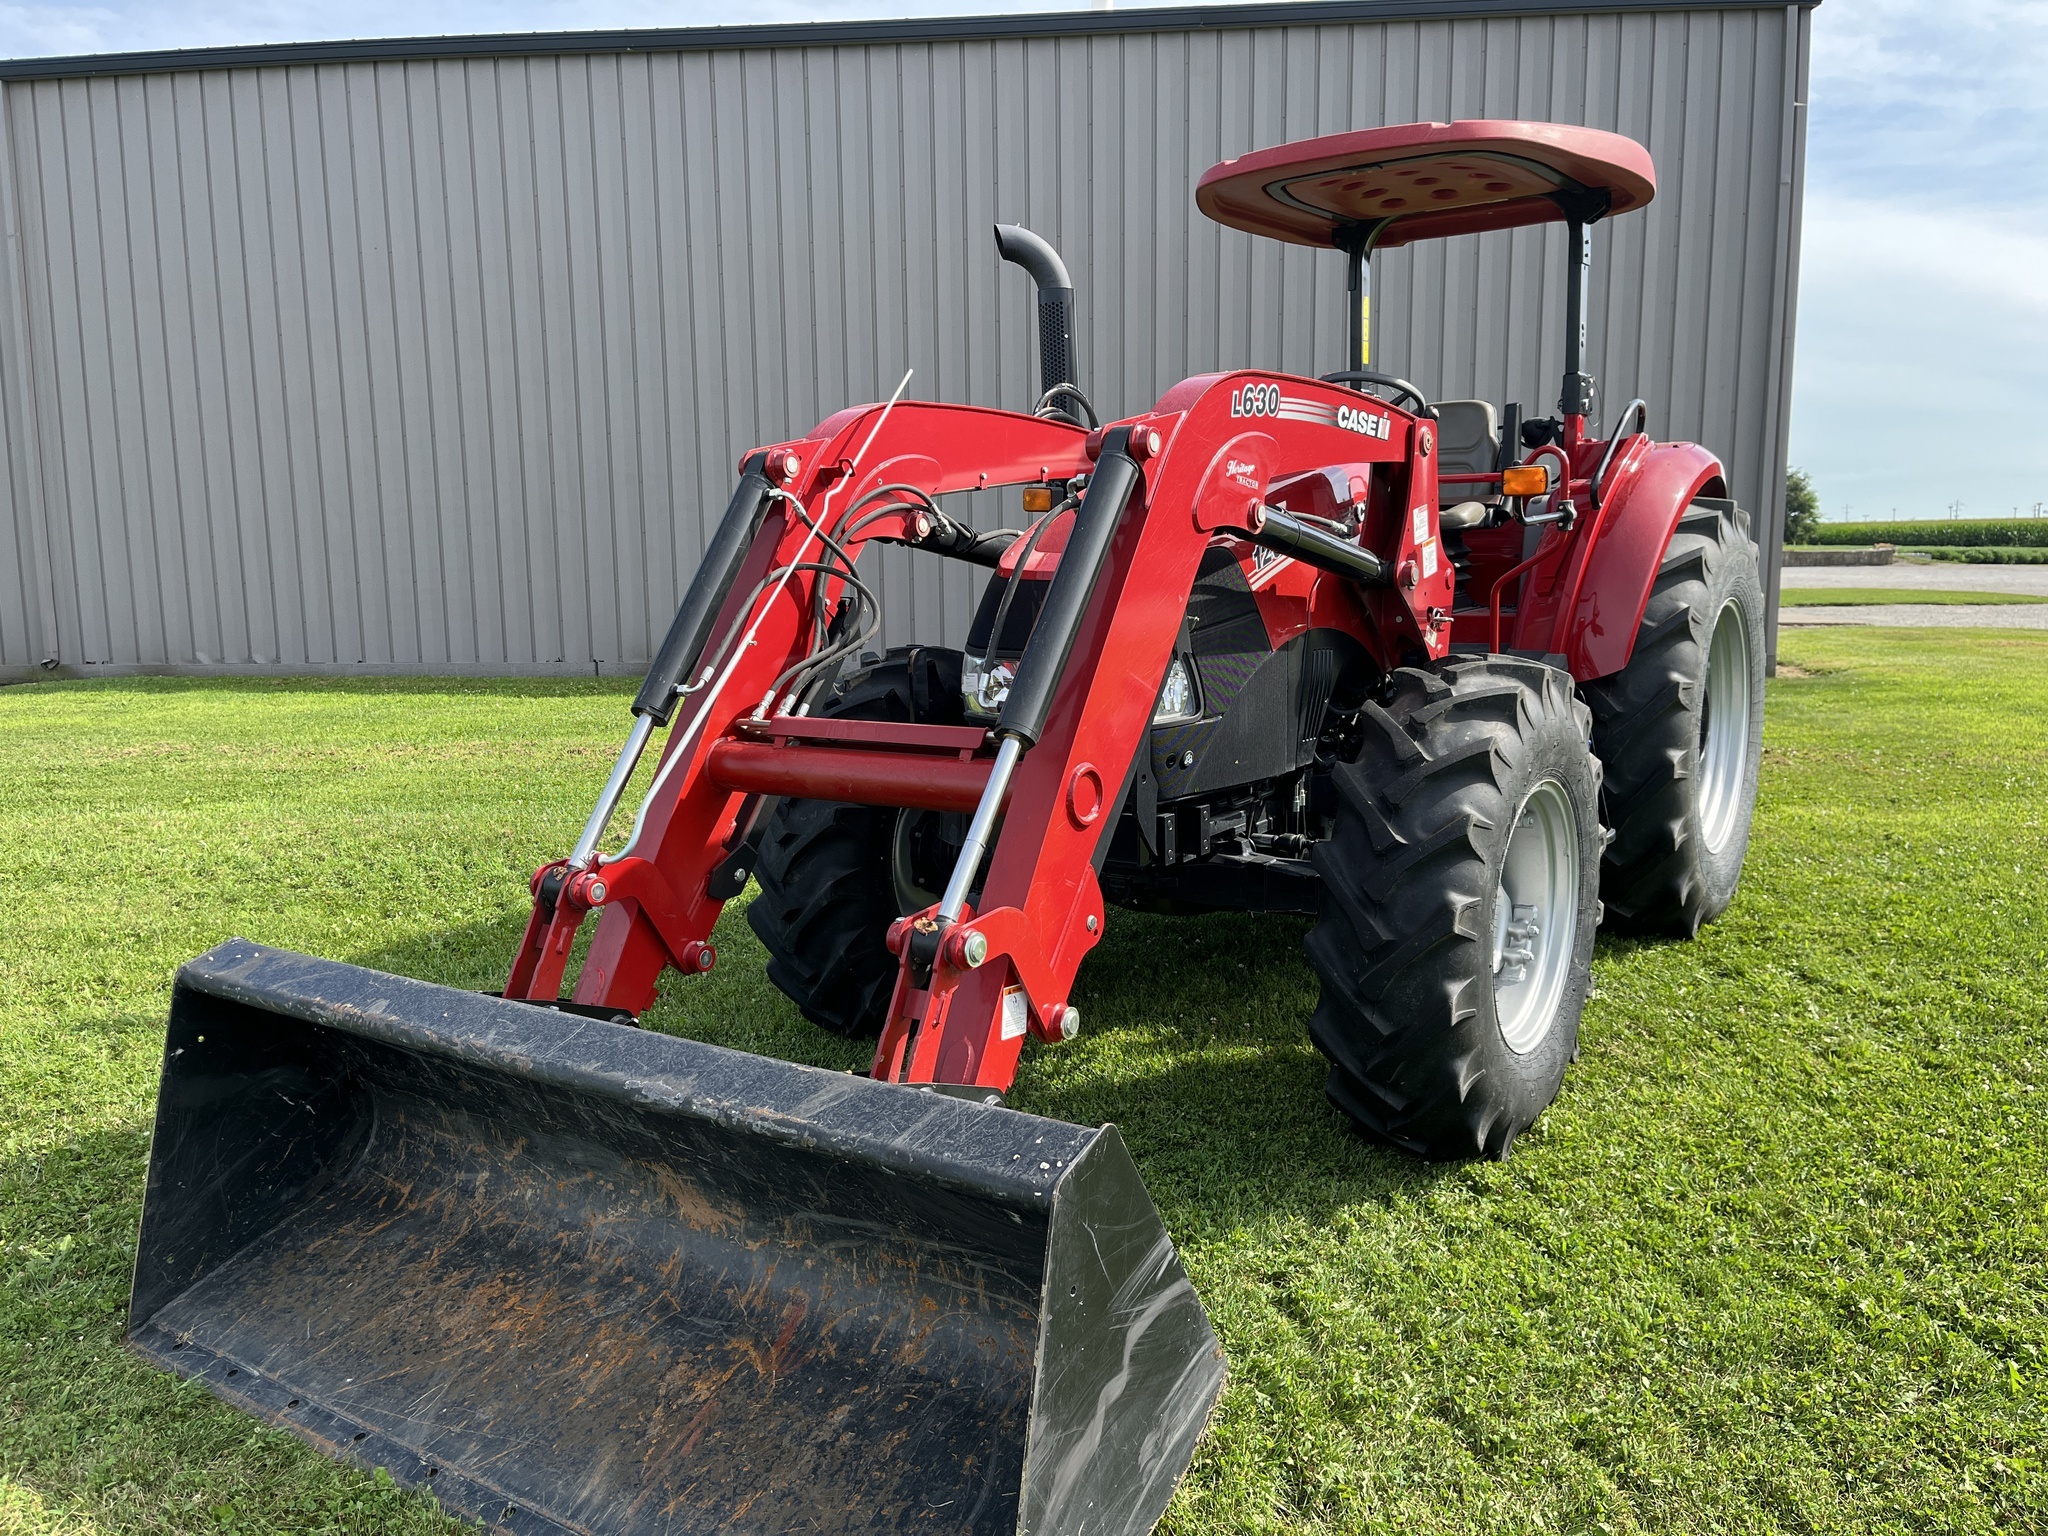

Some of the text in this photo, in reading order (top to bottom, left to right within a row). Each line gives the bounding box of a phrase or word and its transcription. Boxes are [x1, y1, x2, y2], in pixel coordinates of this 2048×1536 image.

[1231, 383, 1280, 418] L630
[1337, 404, 1378, 437] CASE
[1226, 459, 1256, 477] Heritage
